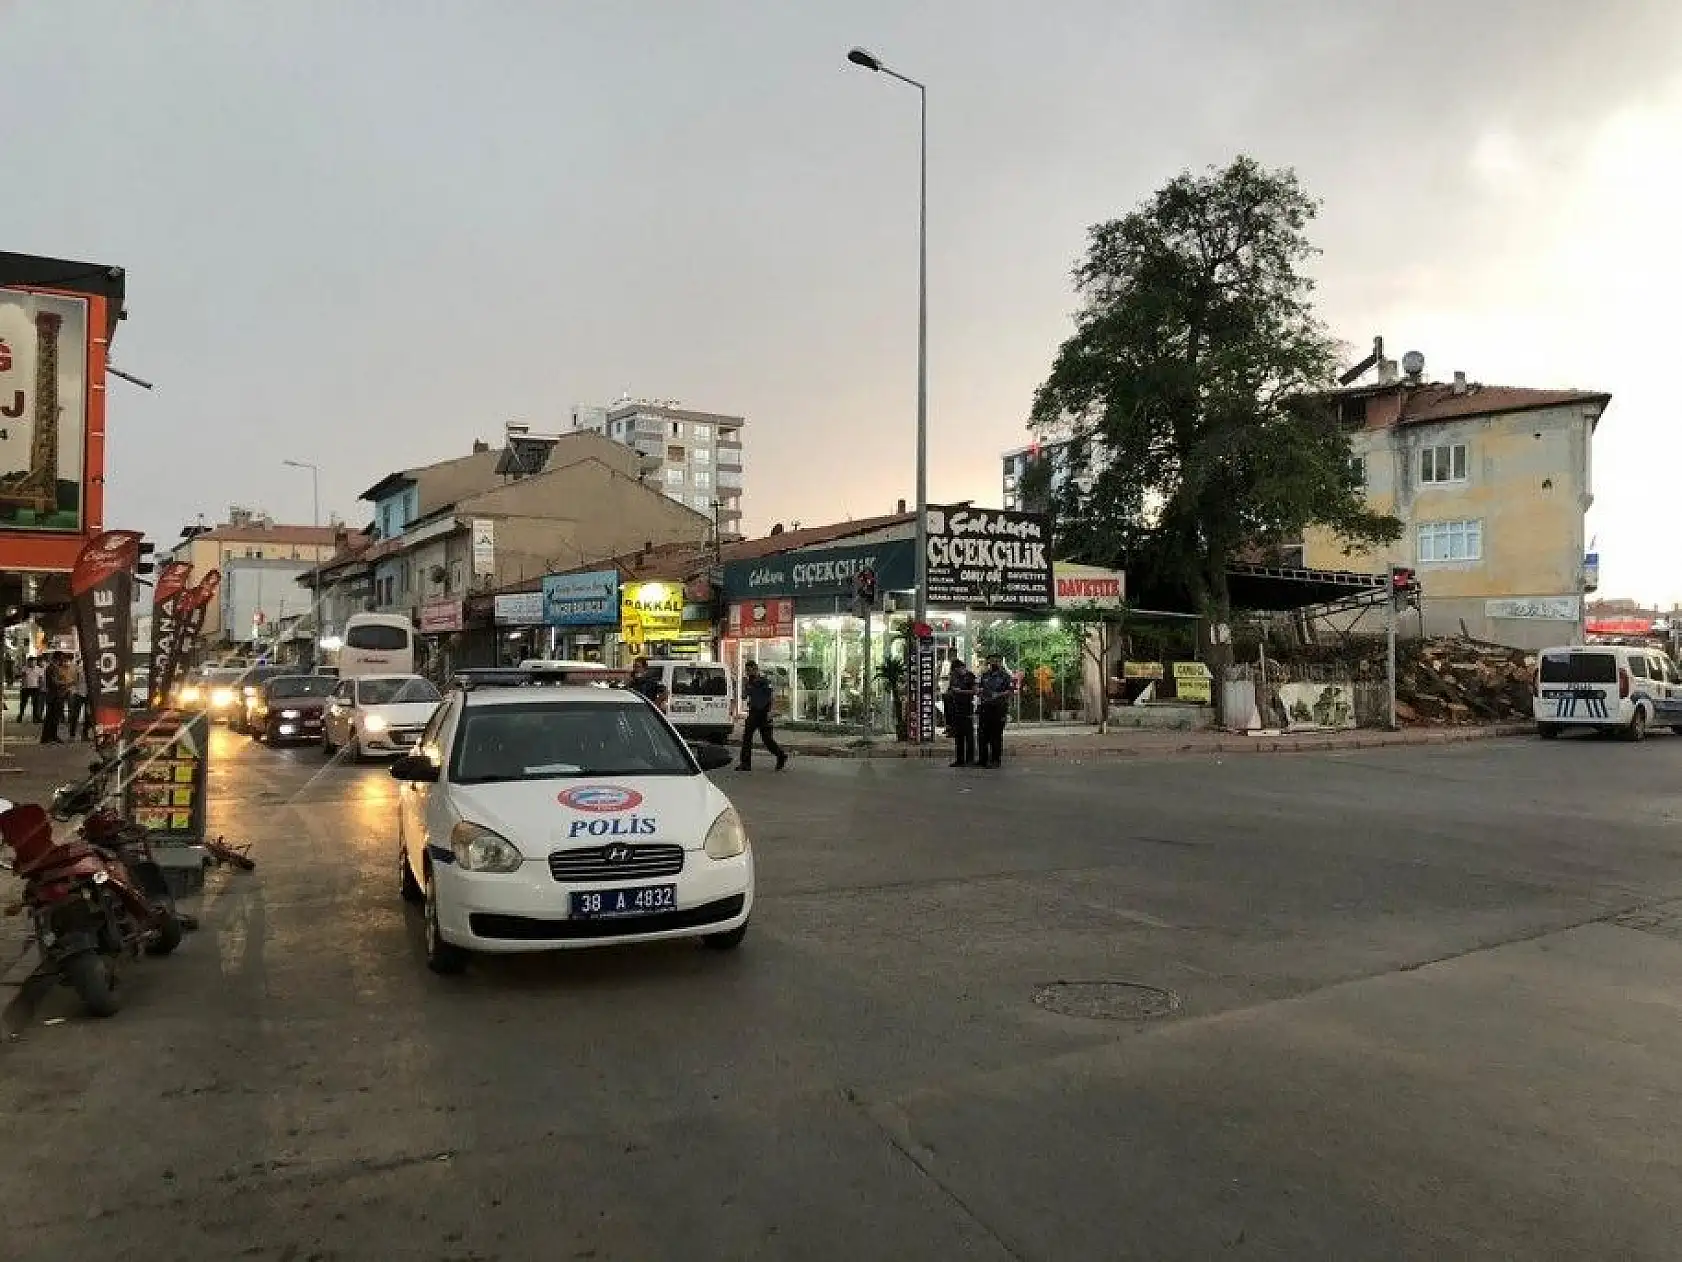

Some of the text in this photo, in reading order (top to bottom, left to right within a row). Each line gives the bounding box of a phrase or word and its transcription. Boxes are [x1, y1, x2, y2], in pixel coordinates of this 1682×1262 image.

[927, 537, 1048, 571] ÇİÇEKÇİLİK
[94, 590, 120, 694] KÖFTE
[568, 814, 656, 838] POLİS
[581, 887, 672, 912] 38 A 4832
